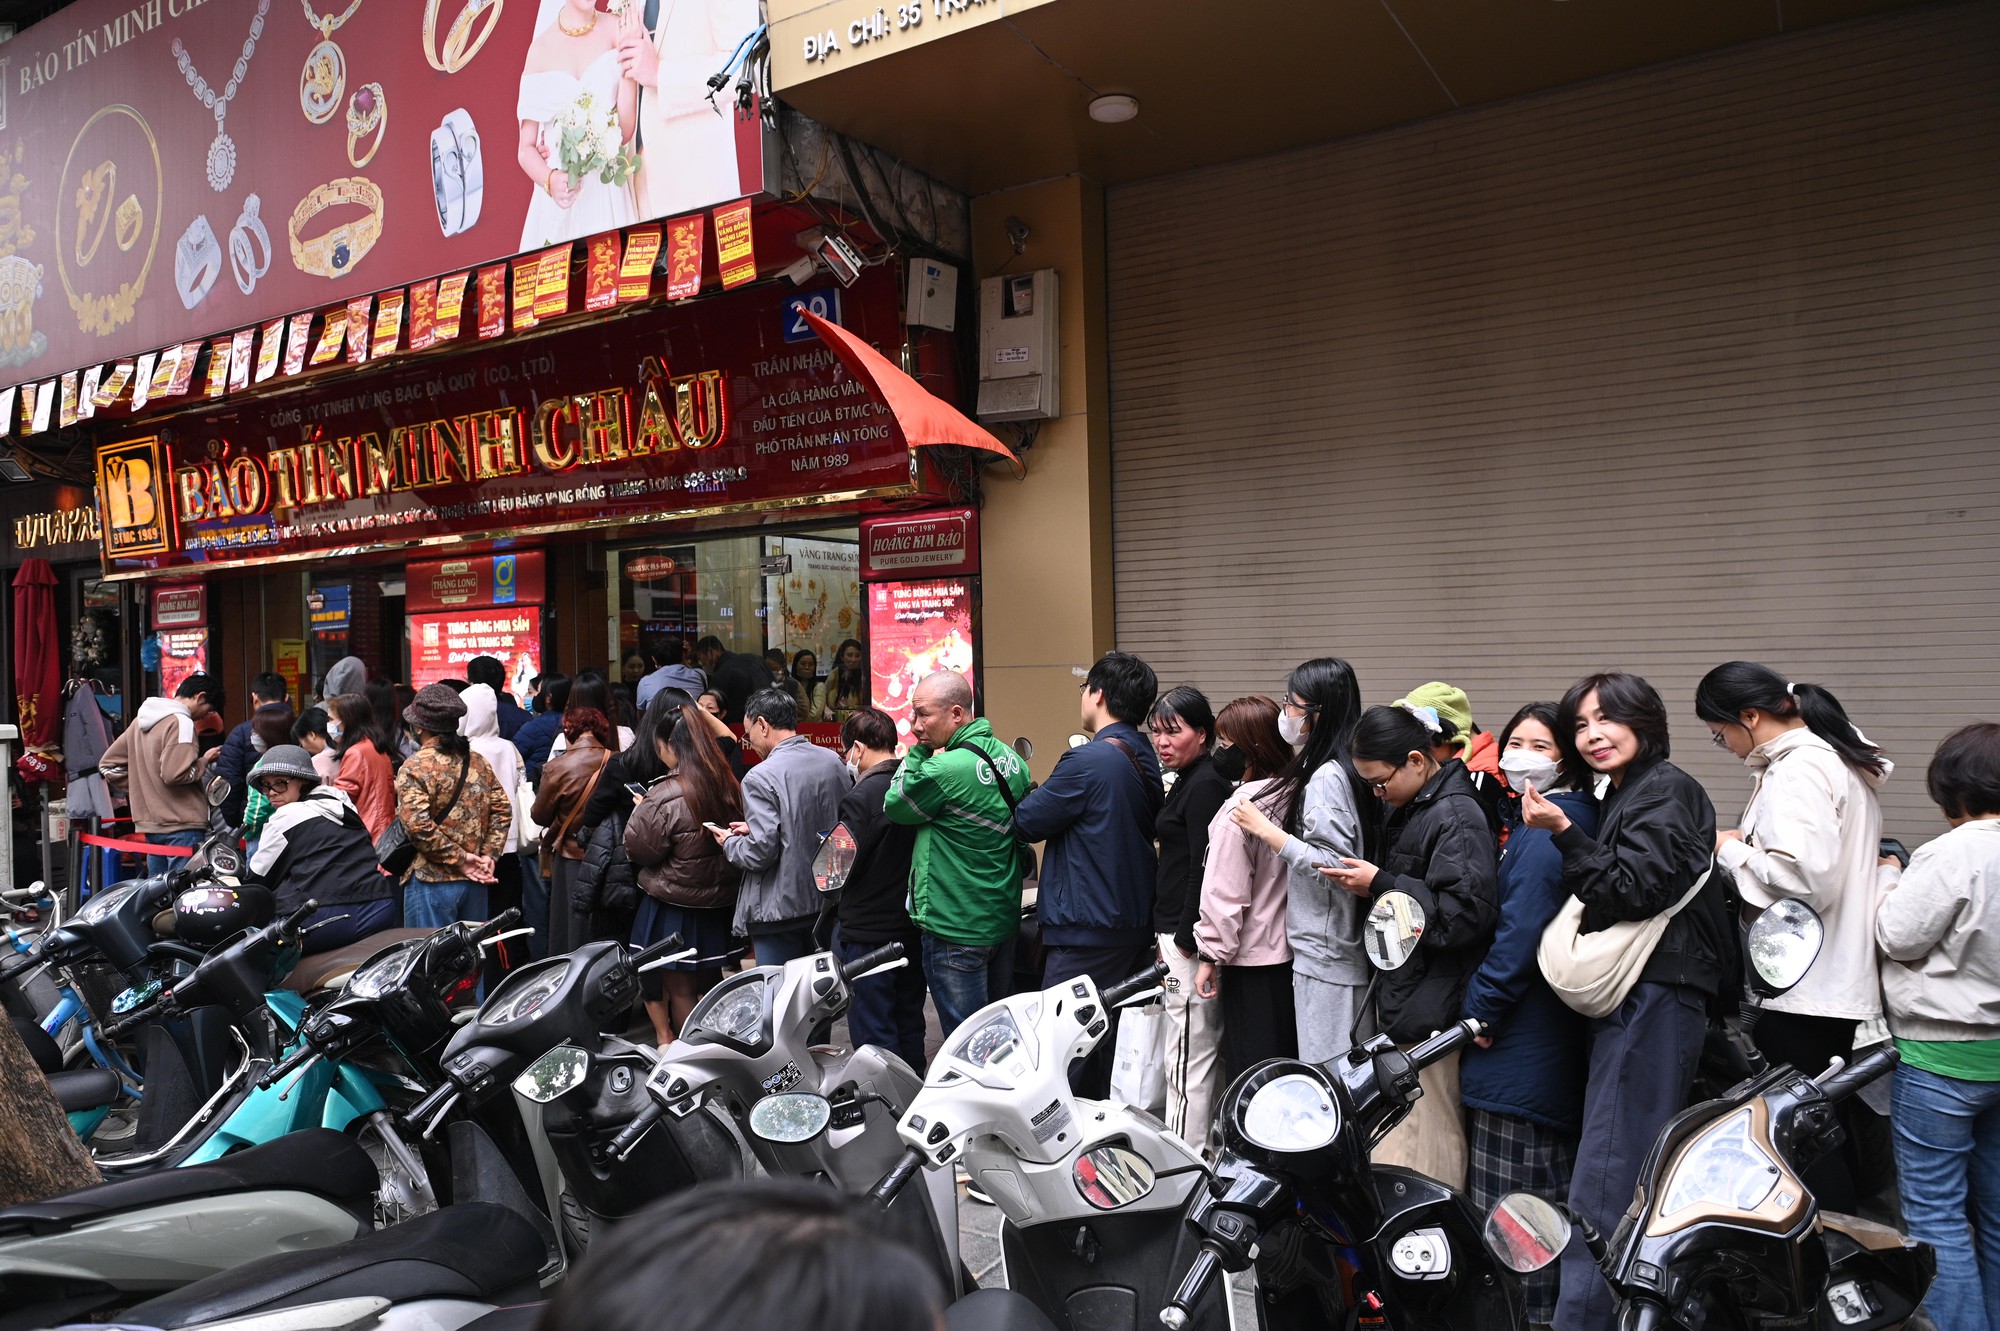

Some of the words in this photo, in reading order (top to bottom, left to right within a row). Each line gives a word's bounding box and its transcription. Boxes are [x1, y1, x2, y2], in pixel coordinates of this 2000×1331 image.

[803, 29, 840, 62] ĐỊA
[848, 7, 890, 45] CHỈ:
[896, 4, 921, 31] 35
[19, 51, 59, 95] BẢO
[63, 29, 98, 72] TÍN
[103, 2, 162, 53] MINH
[752, 356, 791, 378] TRẦN
[803, 382, 839, 402] HÀNG
[841, 381, 867, 396] VÀN
[835, 403, 870, 421] BTMC
[178, 439, 262, 523] BẢO
[267, 424, 353, 508] TÍN
[361, 406, 521, 495] MINH
[532, 356, 719, 470] CHÂU
[852, 424, 889, 442] TÔNG
[791, 453, 819, 472] NĂM
[822, 453, 849, 468] 1989
[114, 530, 136, 545] BTMC
[137, 526, 159, 541] 1989
[897, 526, 918, 534] BTMC
[919, 524, 936, 532] 1989
[873, 534, 911, 552] HOÀNG
[913, 535, 934, 549] KIM
[937, 528, 961, 546] BẢO
[799, 547, 820, 559] VÀNG
[822, 551, 847, 562] TRANG
[880, 557, 898, 565] PURE
[900, 555, 920, 564] GOLD
[921, 553, 954, 562] JEWELRY
[457, 578, 476, 588] LONG
[815, 735, 832, 744] BẢO
